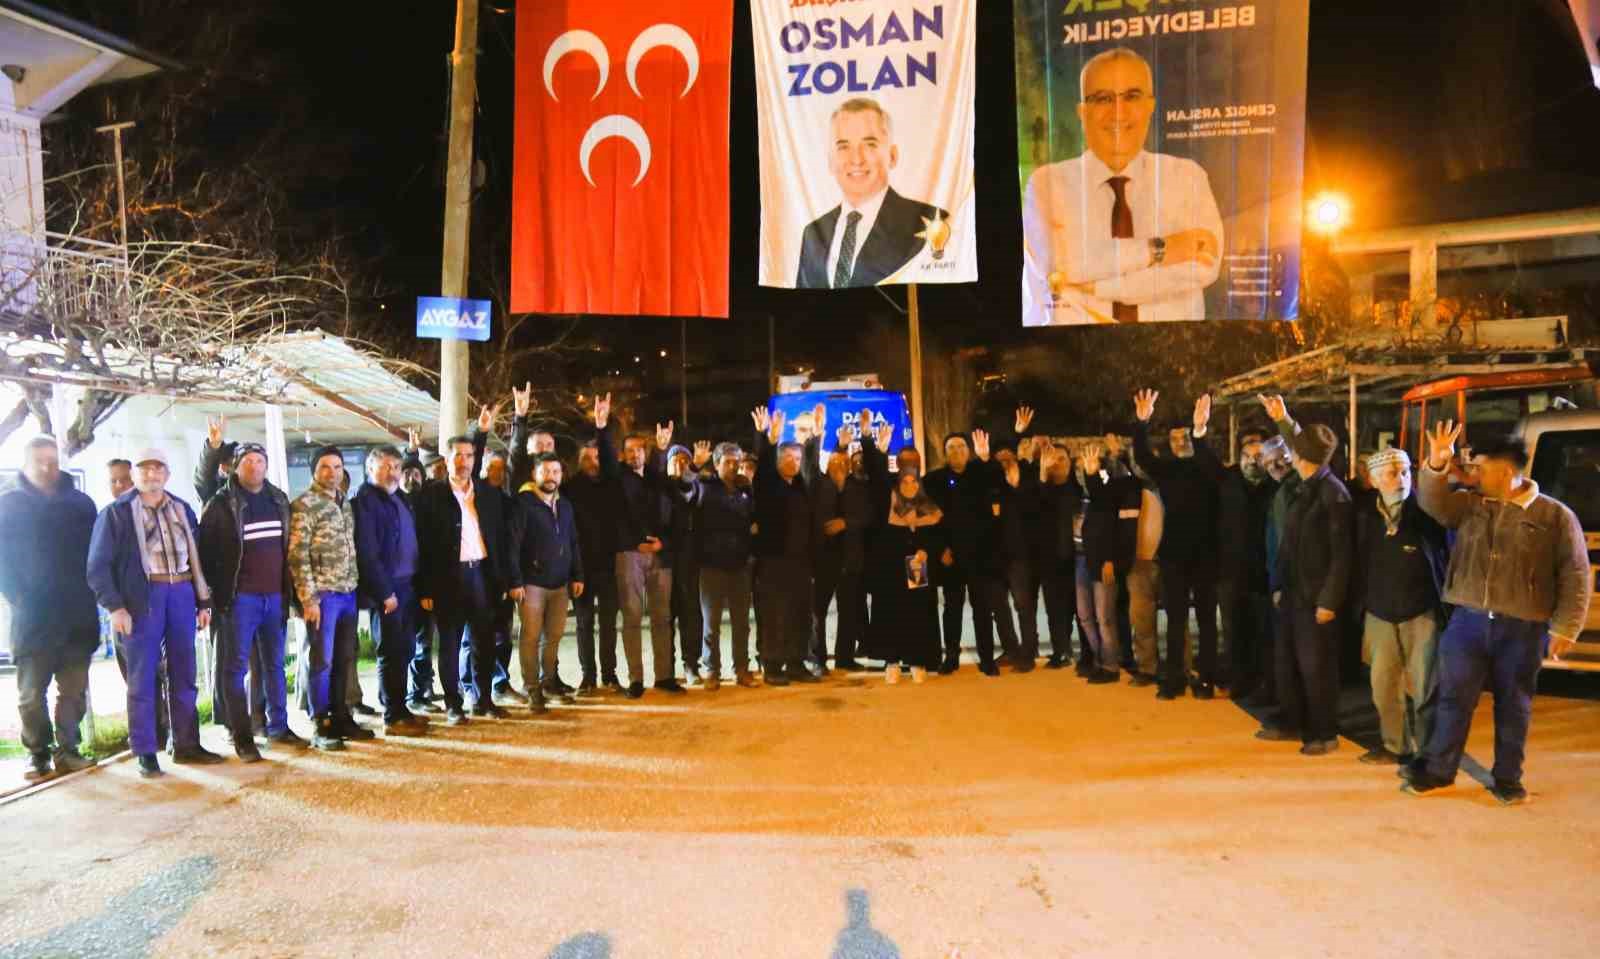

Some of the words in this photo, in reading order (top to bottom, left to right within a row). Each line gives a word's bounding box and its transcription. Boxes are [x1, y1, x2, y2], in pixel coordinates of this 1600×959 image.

[780, 5, 943, 53] OSMAN
[788, 52, 937, 96] ZOLAN
[420, 309, 488, 329] AYGAZ
